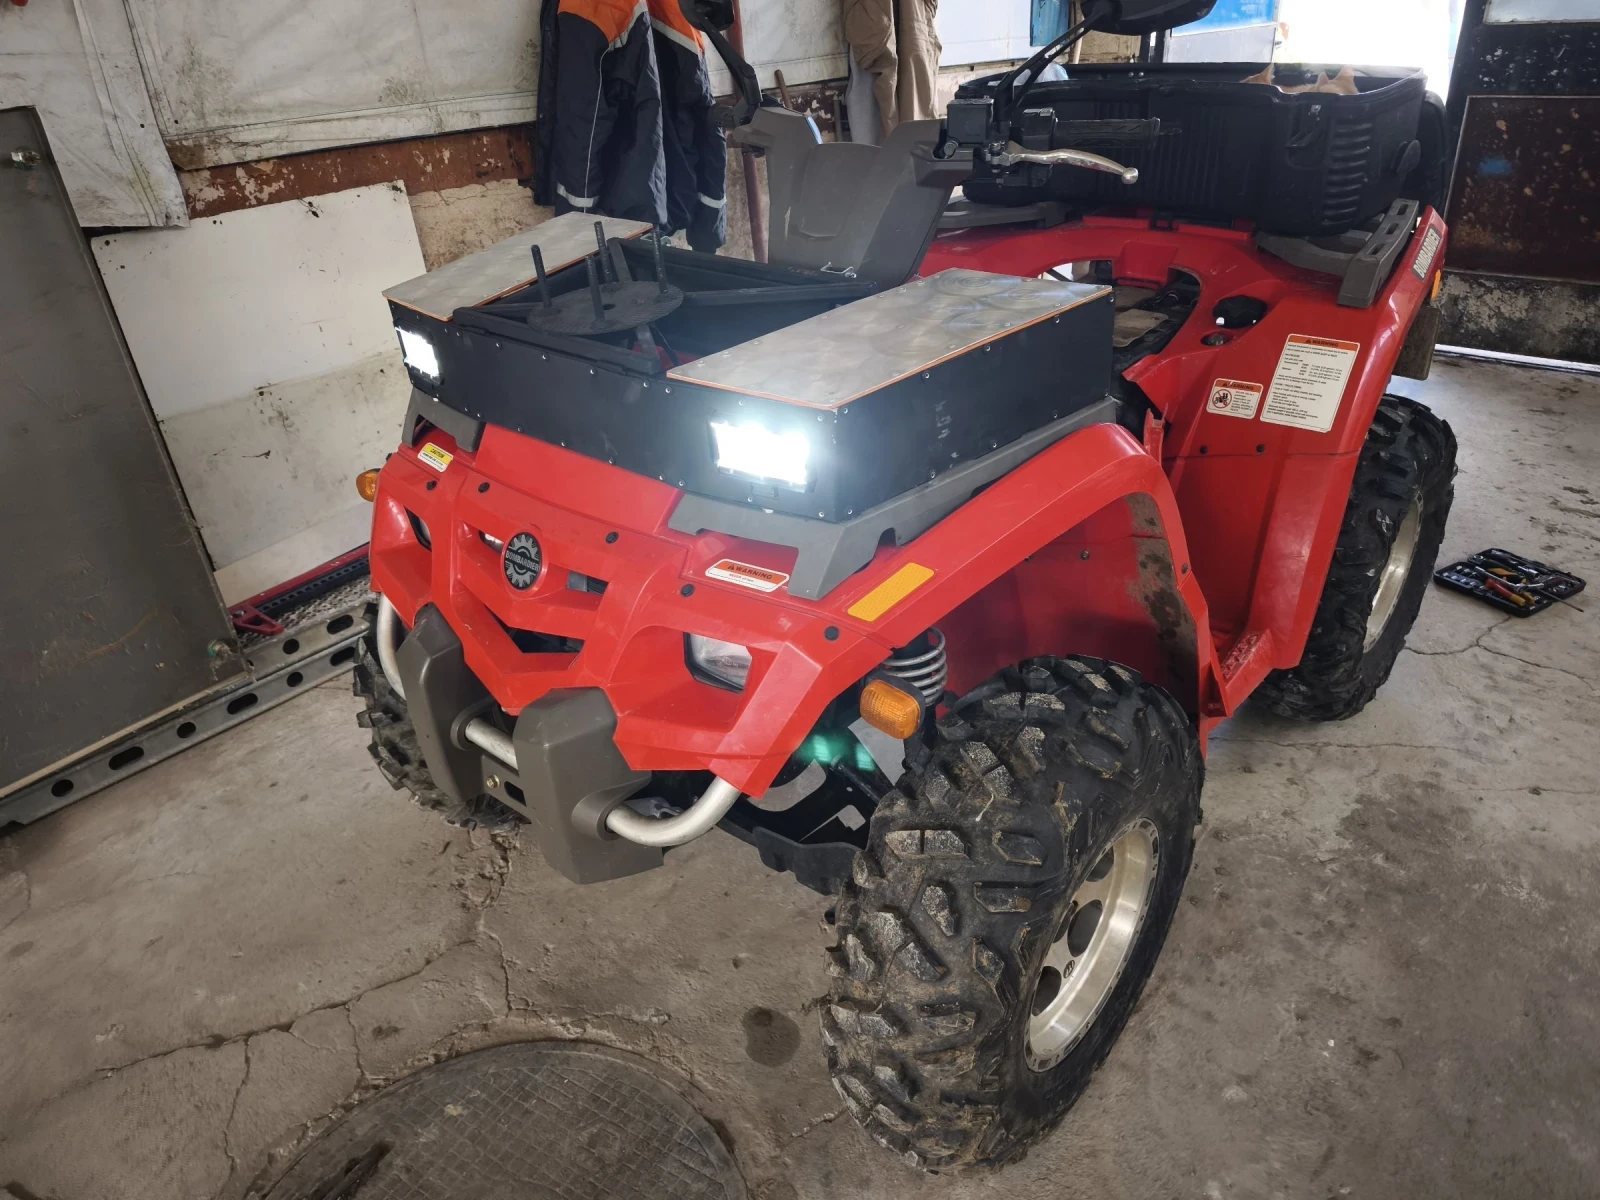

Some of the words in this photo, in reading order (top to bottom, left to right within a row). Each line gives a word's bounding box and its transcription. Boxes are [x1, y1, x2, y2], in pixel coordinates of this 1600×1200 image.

[1413, 228, 1440, 279] BOMBARDIER
[1312, 340, 1338, 348] WARNING
[430, 448, 445, 458] CAUTION
[505, 551, 541, 571] BOMBARDIER
[736, 565, 772, 580] WARNING
